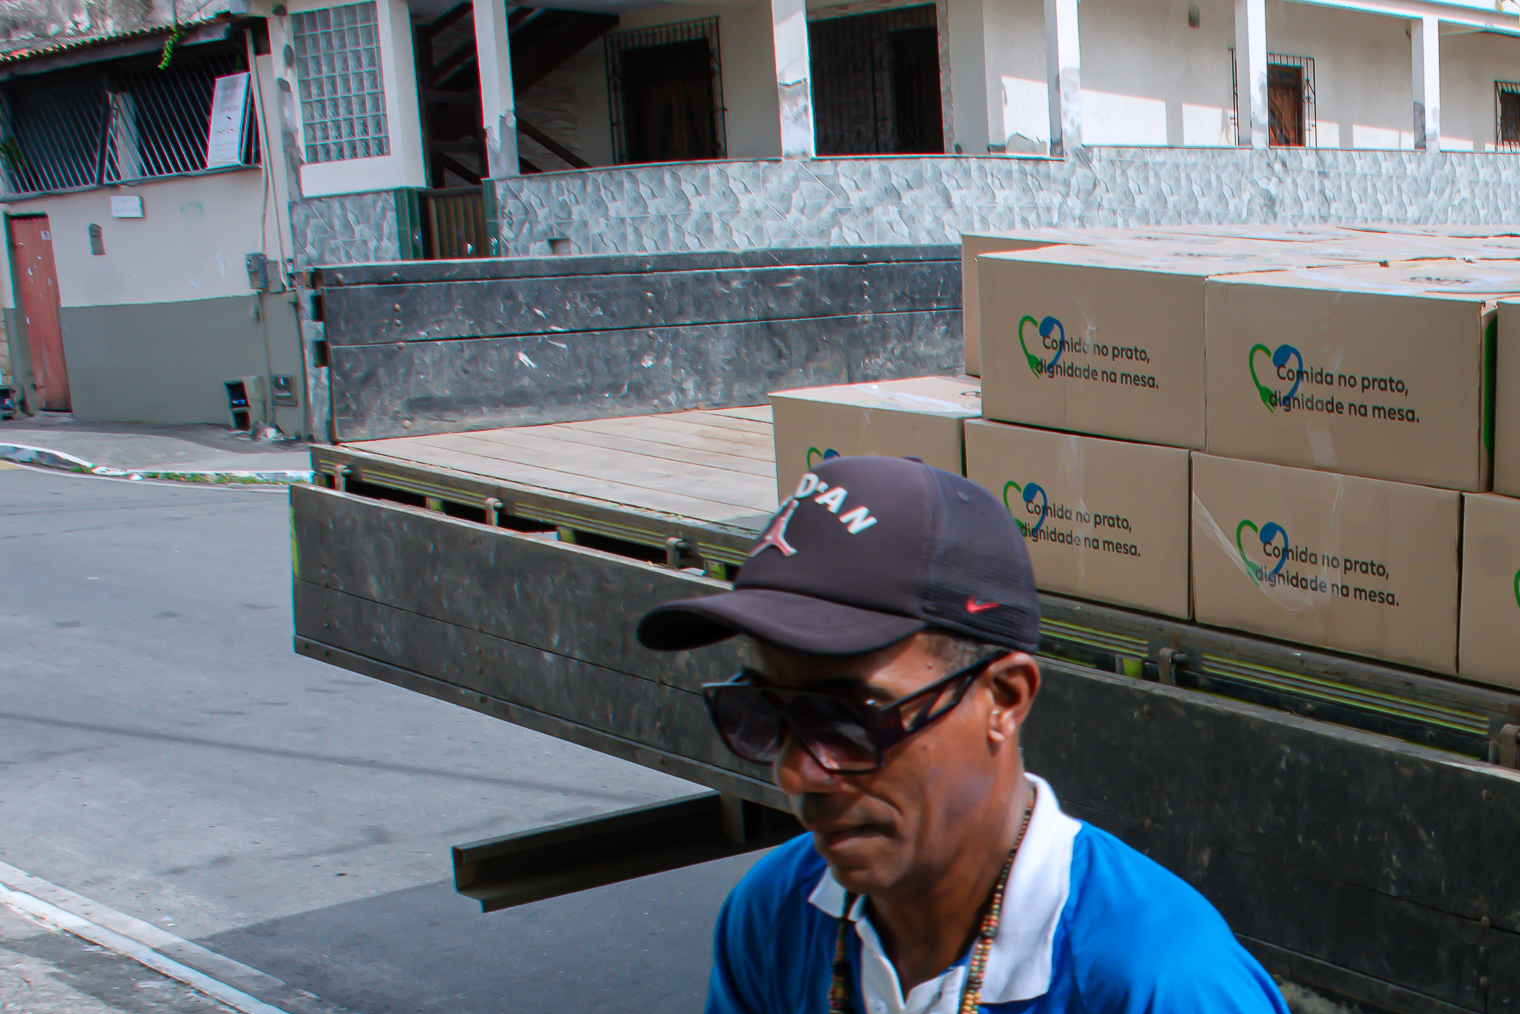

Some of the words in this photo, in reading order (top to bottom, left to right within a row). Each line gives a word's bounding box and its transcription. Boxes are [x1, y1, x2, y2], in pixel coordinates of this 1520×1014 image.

[1043, 334, 1089, 354] Comida
[1092, 341, 1109, 358] no
[1112, 345, 1151, 364] prato,
[1036, 359, 1098, 381] dignidade
[1101, 368, 1117, 384] na
[1120, 371, 1159, 390] mesa.
[1277, 364, 1334, 386] Comida
[1338, 374, 1357, 390] no
[1361, 376, 1409, 396] prato,
[1269, 390, 1344, 414] dignidade
[1348, 400, 1368, 418] na
[1372, 404, 1419, 424] mesa.
[1026, 500, 1072, 520] Comida
[1075, 508, 1091, 524] no
[1094, 512, 1132, 531] prato,
[1021, 523, 1081, 547] dignidade
[1084, 534, 1100, 550] na
[1102, 538, 1141, 557] mesa.
[1263, 541, 1318, 566] Comida
[1322, 554, 1340, 570] no
[1343, 557, 1390, 580] prato,
[1255, 565, 1327, 594] dignidade
[1331, 581, 1350, 597] na
[1353, 586, 1400, 607] mesa.
